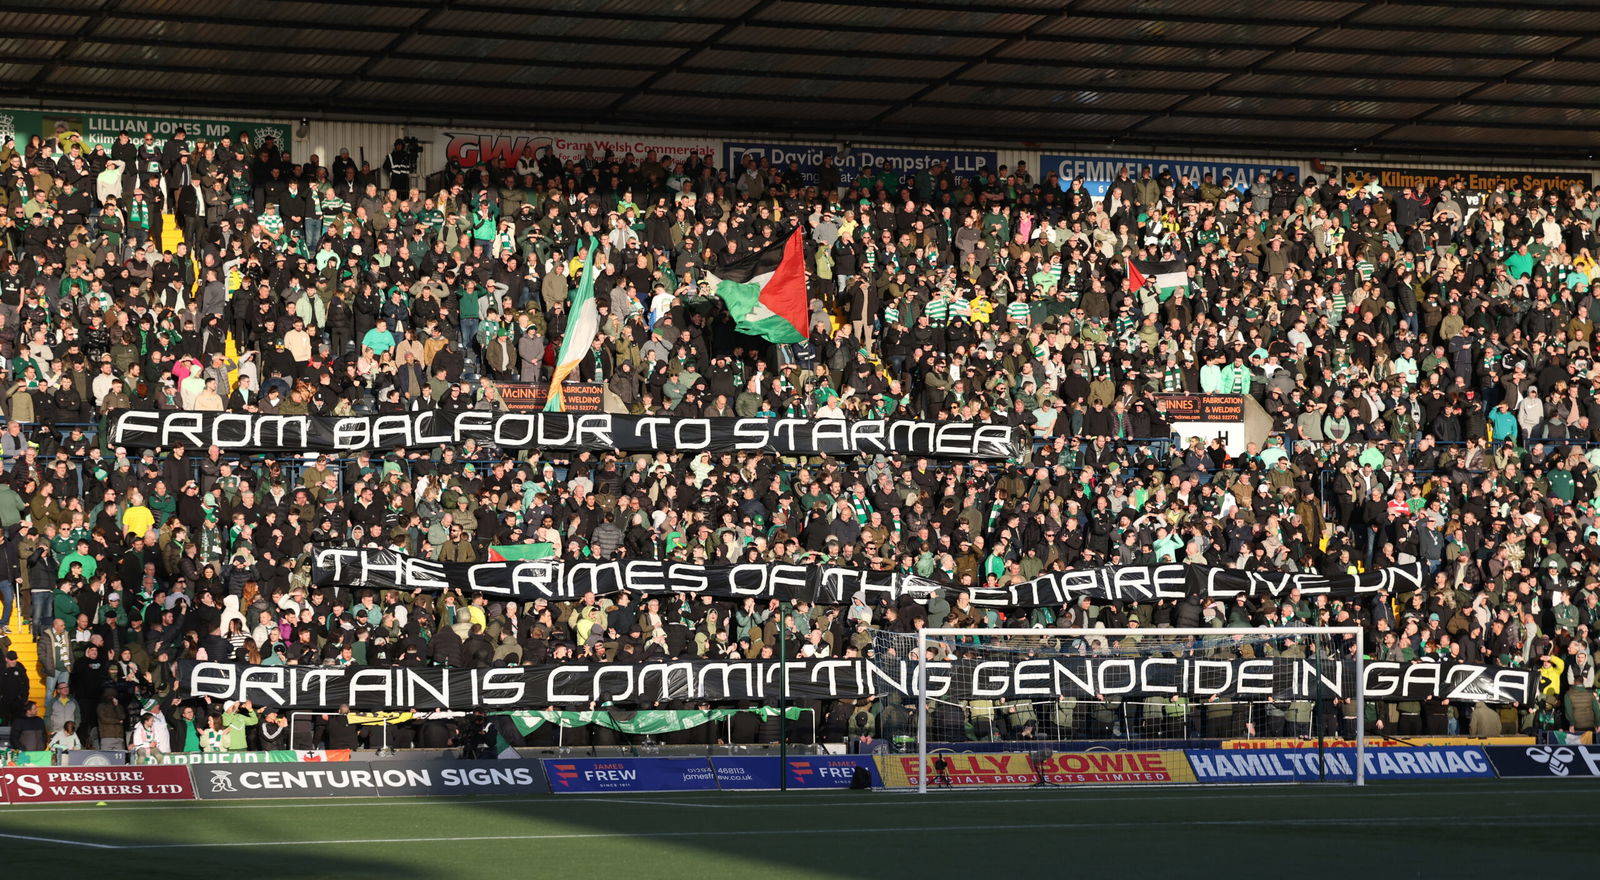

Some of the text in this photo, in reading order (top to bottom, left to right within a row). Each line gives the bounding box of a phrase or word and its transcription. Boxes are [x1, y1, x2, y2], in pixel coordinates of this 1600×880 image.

[89, 118, 230, 136] LILLIAN JONES MP
[595, 140, 632, 152] Welsh
[634, 142, 715, 155] Commercials
[771, 149, 856, 167] Davidon
[954, 156, 986, 171] LLP
[1175, 164, 1217, 186] VAN
[1469, 174, 1519, 191] Engine
[502, 388, 547, 398] McINNES
[563, 386, 603, 394] ABRICATION
[569, 396, 600, 404] WELDING
[1166, 400, 1193, 410] INNES
[1212, 406, 1240, 414] WELDING
[115, 410, 1012, 455] FROM BALFOUR TO STARMER
[1218, 431, 1228, 446] H
[317, 548, 449, 588] THE
[467, 560, 708, 597] CRIMES
[729, 564, 807, 595] OF
[822, 569, 942, 605] THE
[969, 564, 1186, 605] EMPIRE
[1207, 567, 1331, 597] LIVE
[190, 658, 1531, 708] BRITAIN IS COMMITTING GENOCIDE IN GAZA
[900, 753, 1168, 775] BILLY BOWIE
[1189, 748, 1488, 777] HAMILTON TARMAC
[47, 772, 144, 782] PRESSURE
[239, 768, 533, 789] CENTURION SIGNS
[584, 769, 637, 781] FREW
[819, 767, 870, 778] FRE
[909, 772, 1165, 785] SECIAL PROJECTS LIMITED
[50, 784, 183, 796] WASHERS LTD
